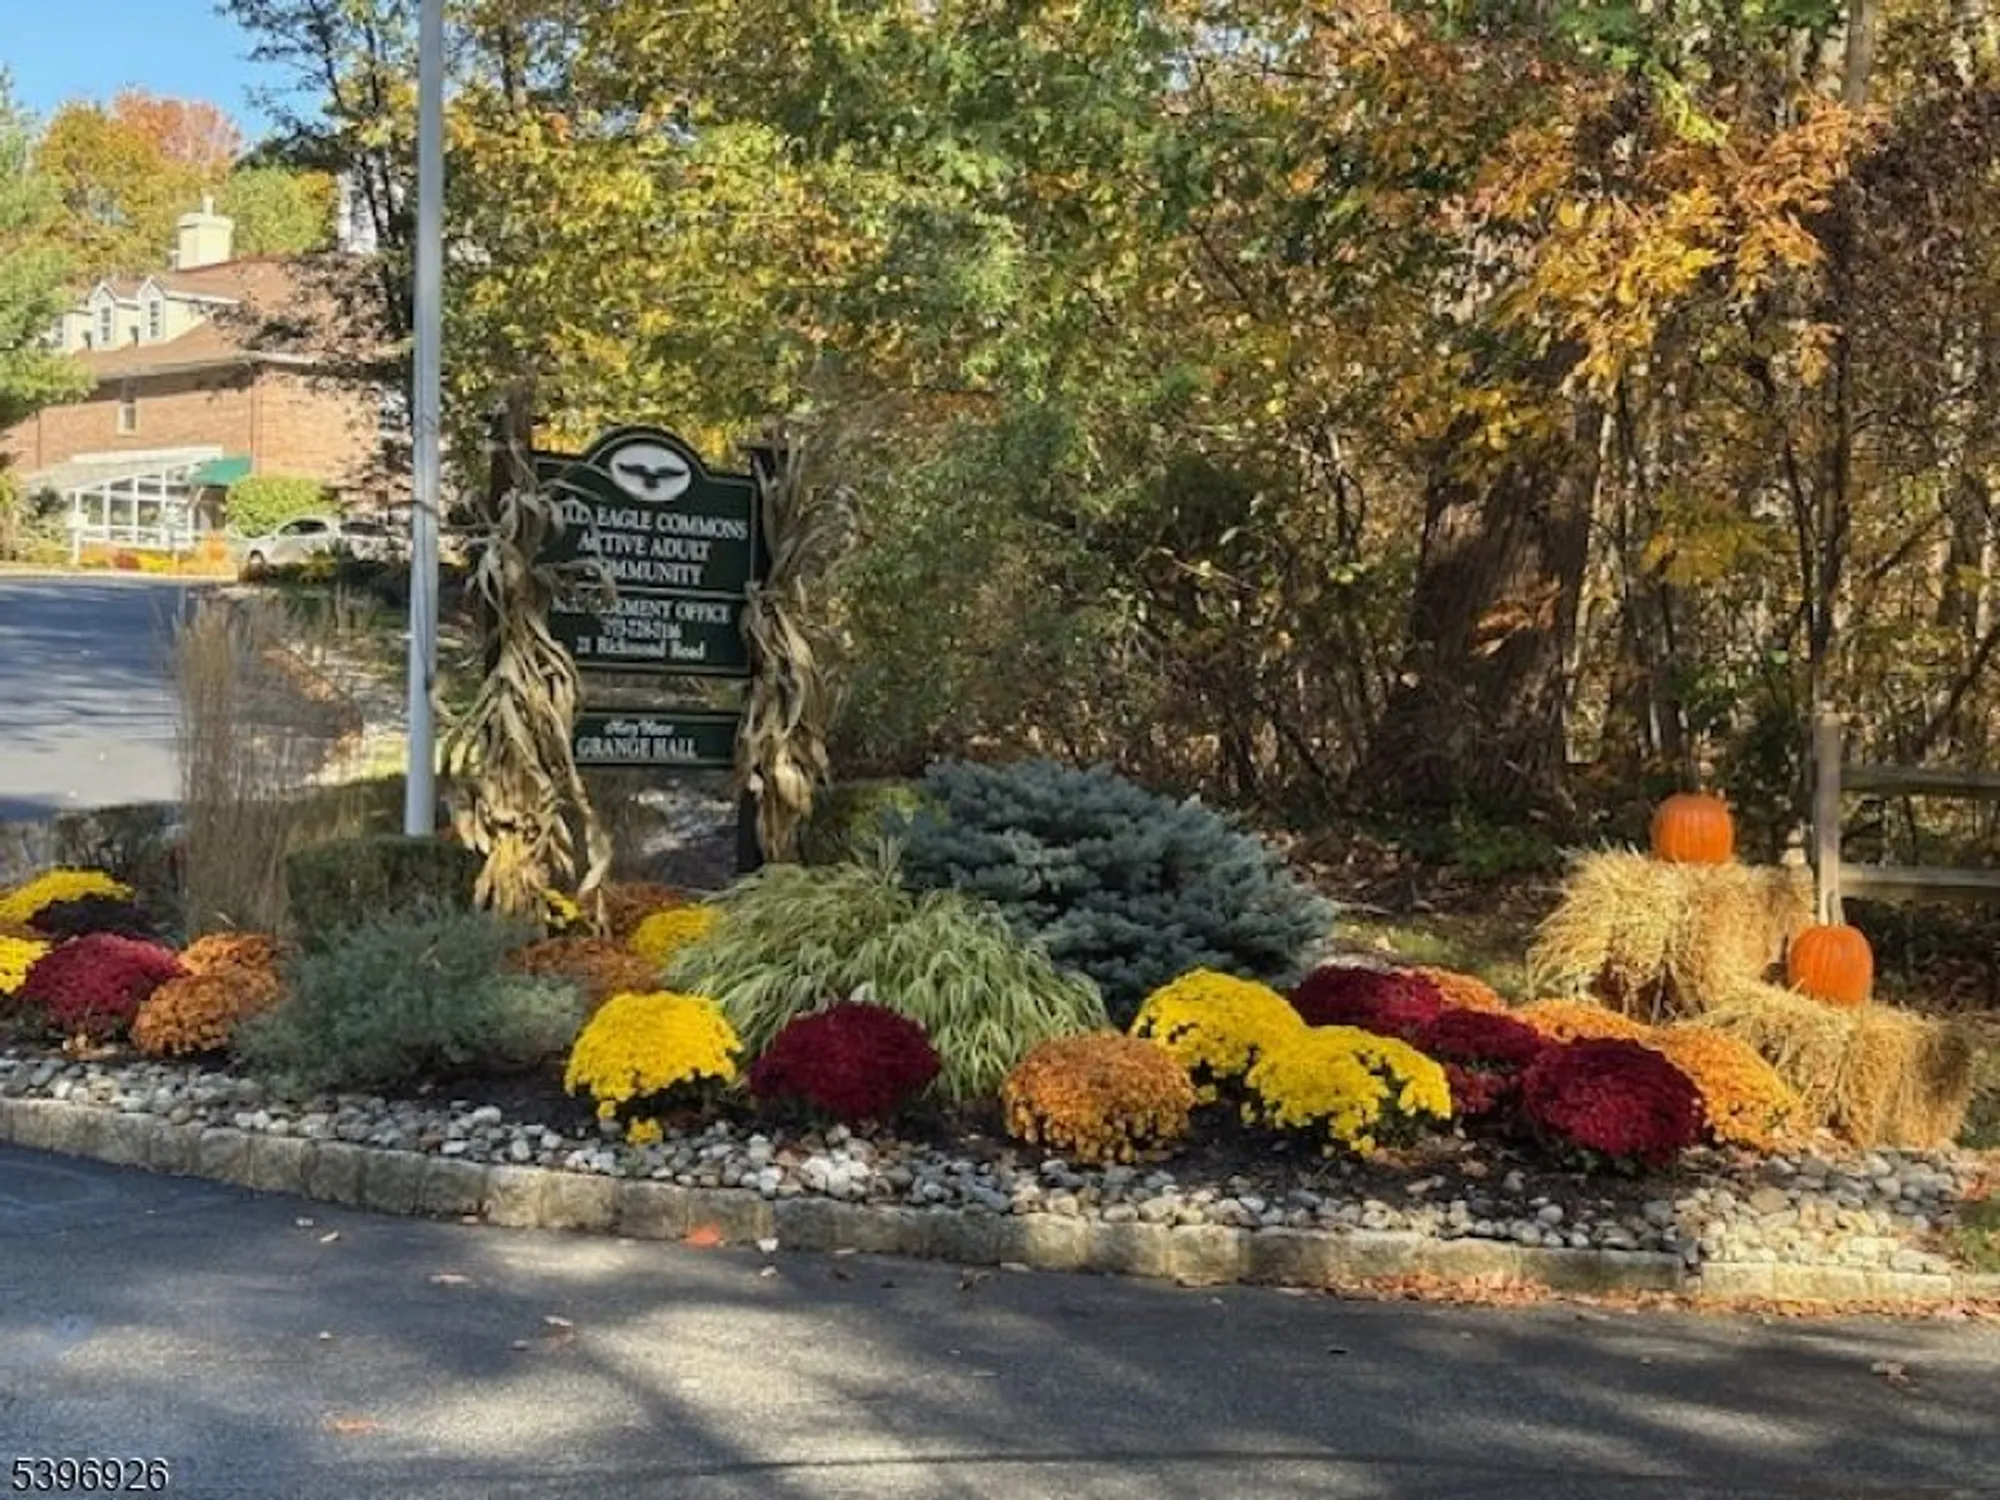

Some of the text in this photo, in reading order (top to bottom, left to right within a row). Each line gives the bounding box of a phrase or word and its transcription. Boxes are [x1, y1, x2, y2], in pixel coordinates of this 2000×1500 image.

[597, 506, 651, 530] EAGLE
[657, 511, 748, 540] COMMONS
[650, 537, 711, 562] ADULT
[674, 602, 730, 625] OFFICE
[576, 737, 699, 761] GRANGE HALL
